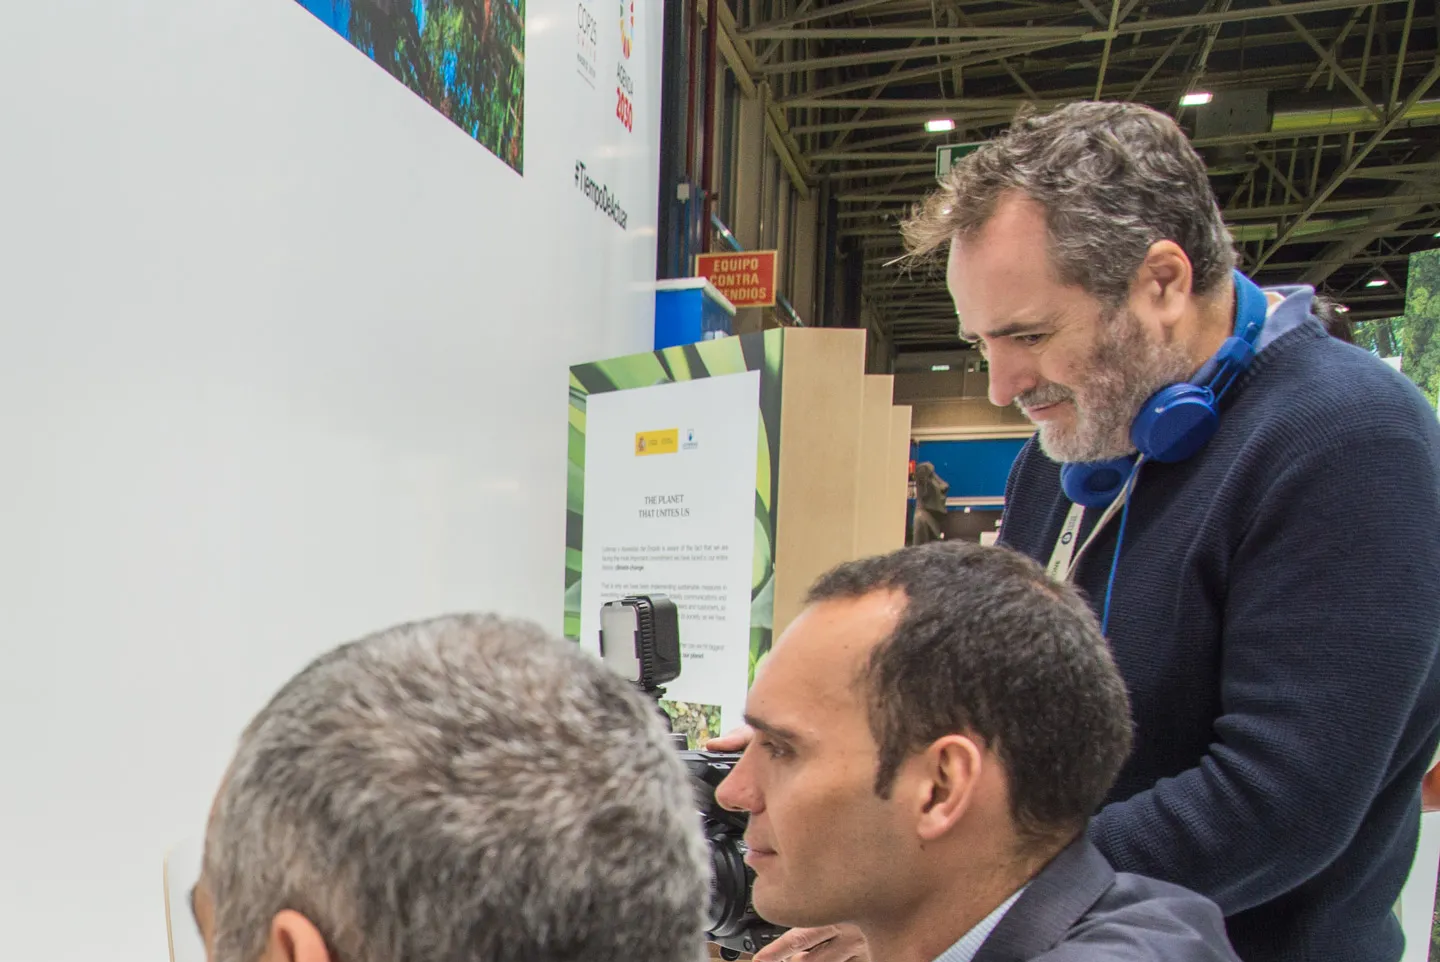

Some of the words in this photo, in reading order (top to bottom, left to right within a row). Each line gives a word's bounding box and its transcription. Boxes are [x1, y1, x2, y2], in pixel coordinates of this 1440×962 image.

[577, 3, 597, 46] COP25
[616, 86, 633, 133] 2030
[574, 159, 628, 231] #TiempoDeActuar
[713, 257, 759, 273] EQUIPO
[710, 272, 760, 288] CONTRA
[721, 287, 767, 301] ENDIOS
[644, 495, 657, 505] THE
[658, 494, 684, 505] PLANET
[639, 509, 655, 518] THAT
[681, 507, 690, 517] US
